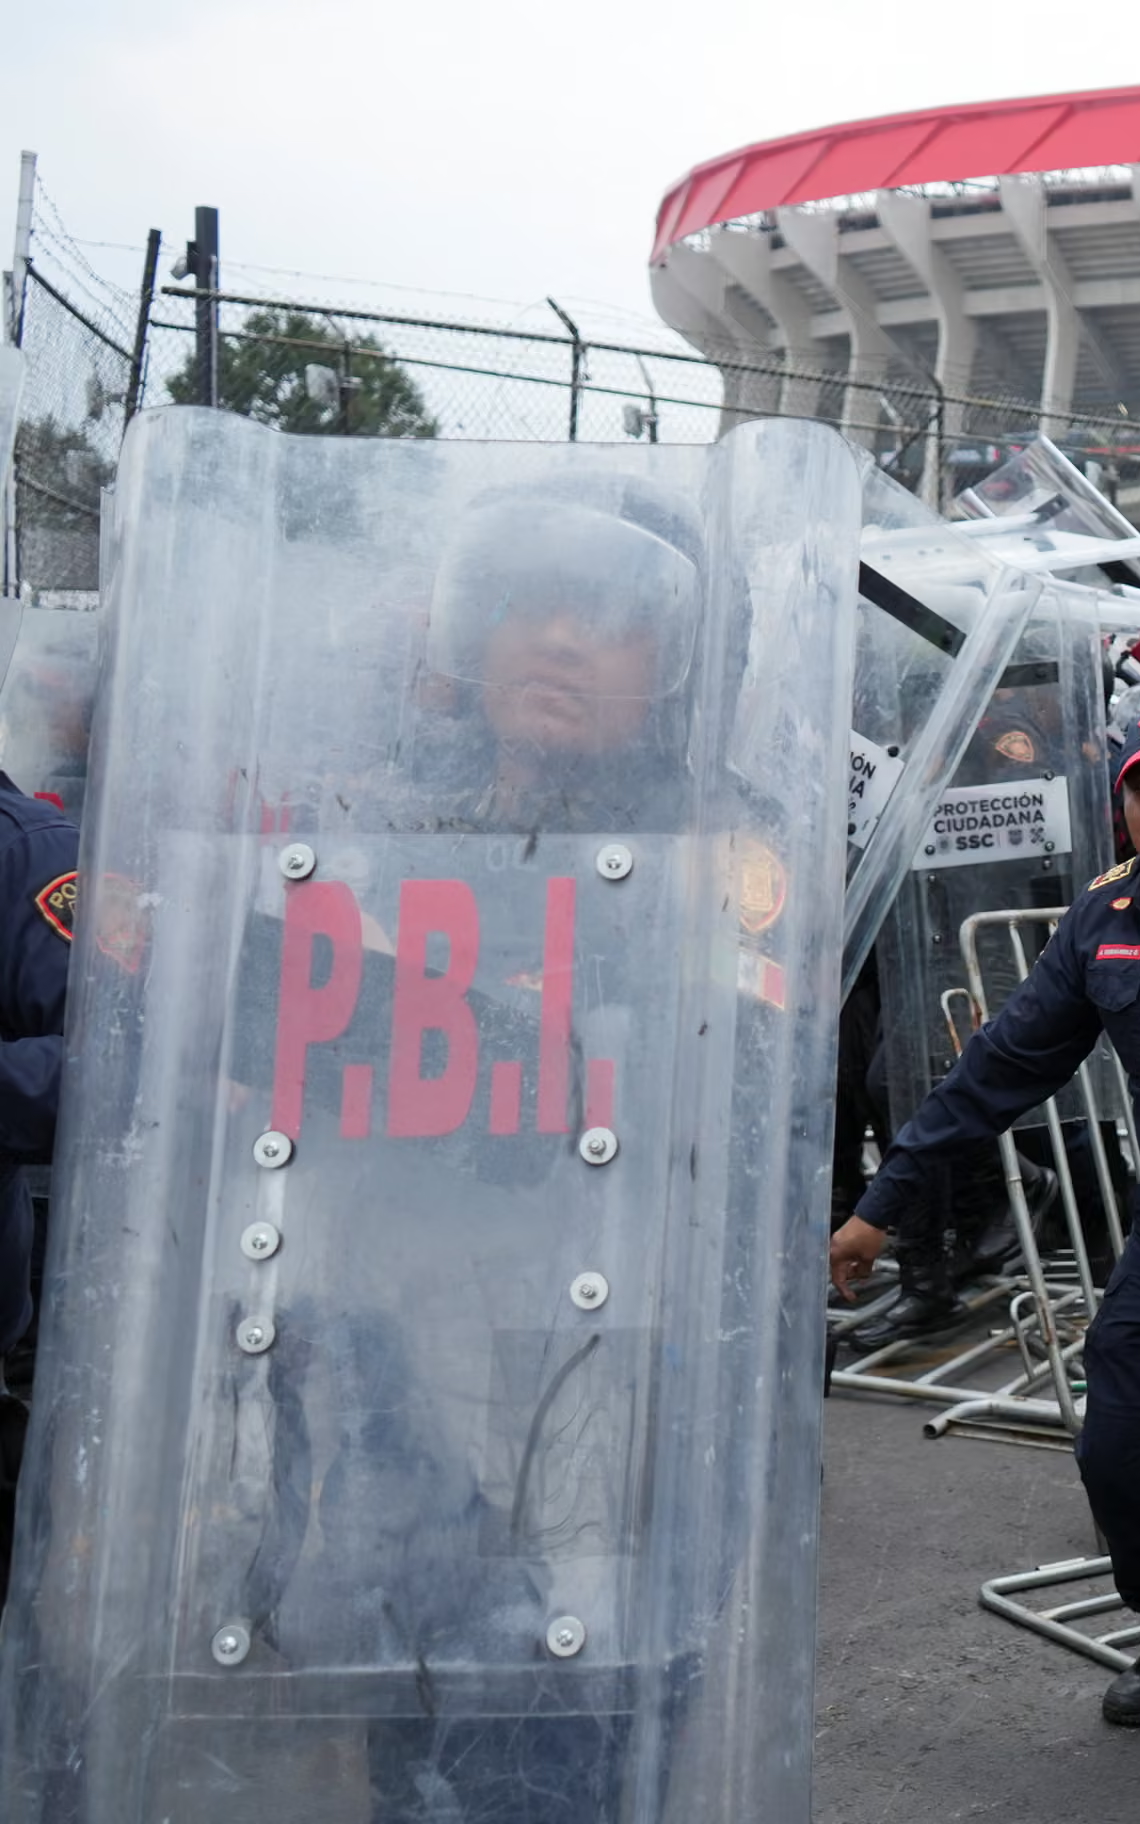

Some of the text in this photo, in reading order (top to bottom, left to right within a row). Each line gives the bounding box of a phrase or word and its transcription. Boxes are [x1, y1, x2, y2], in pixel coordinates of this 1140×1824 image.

[934, 792, 1043, 817] PROTECCIÓN
[934, 810, 1045, 834] CIUDADANA
[955, 833, 995, 850] SSC
[270, 876, 615, 1140] P.B.I.
